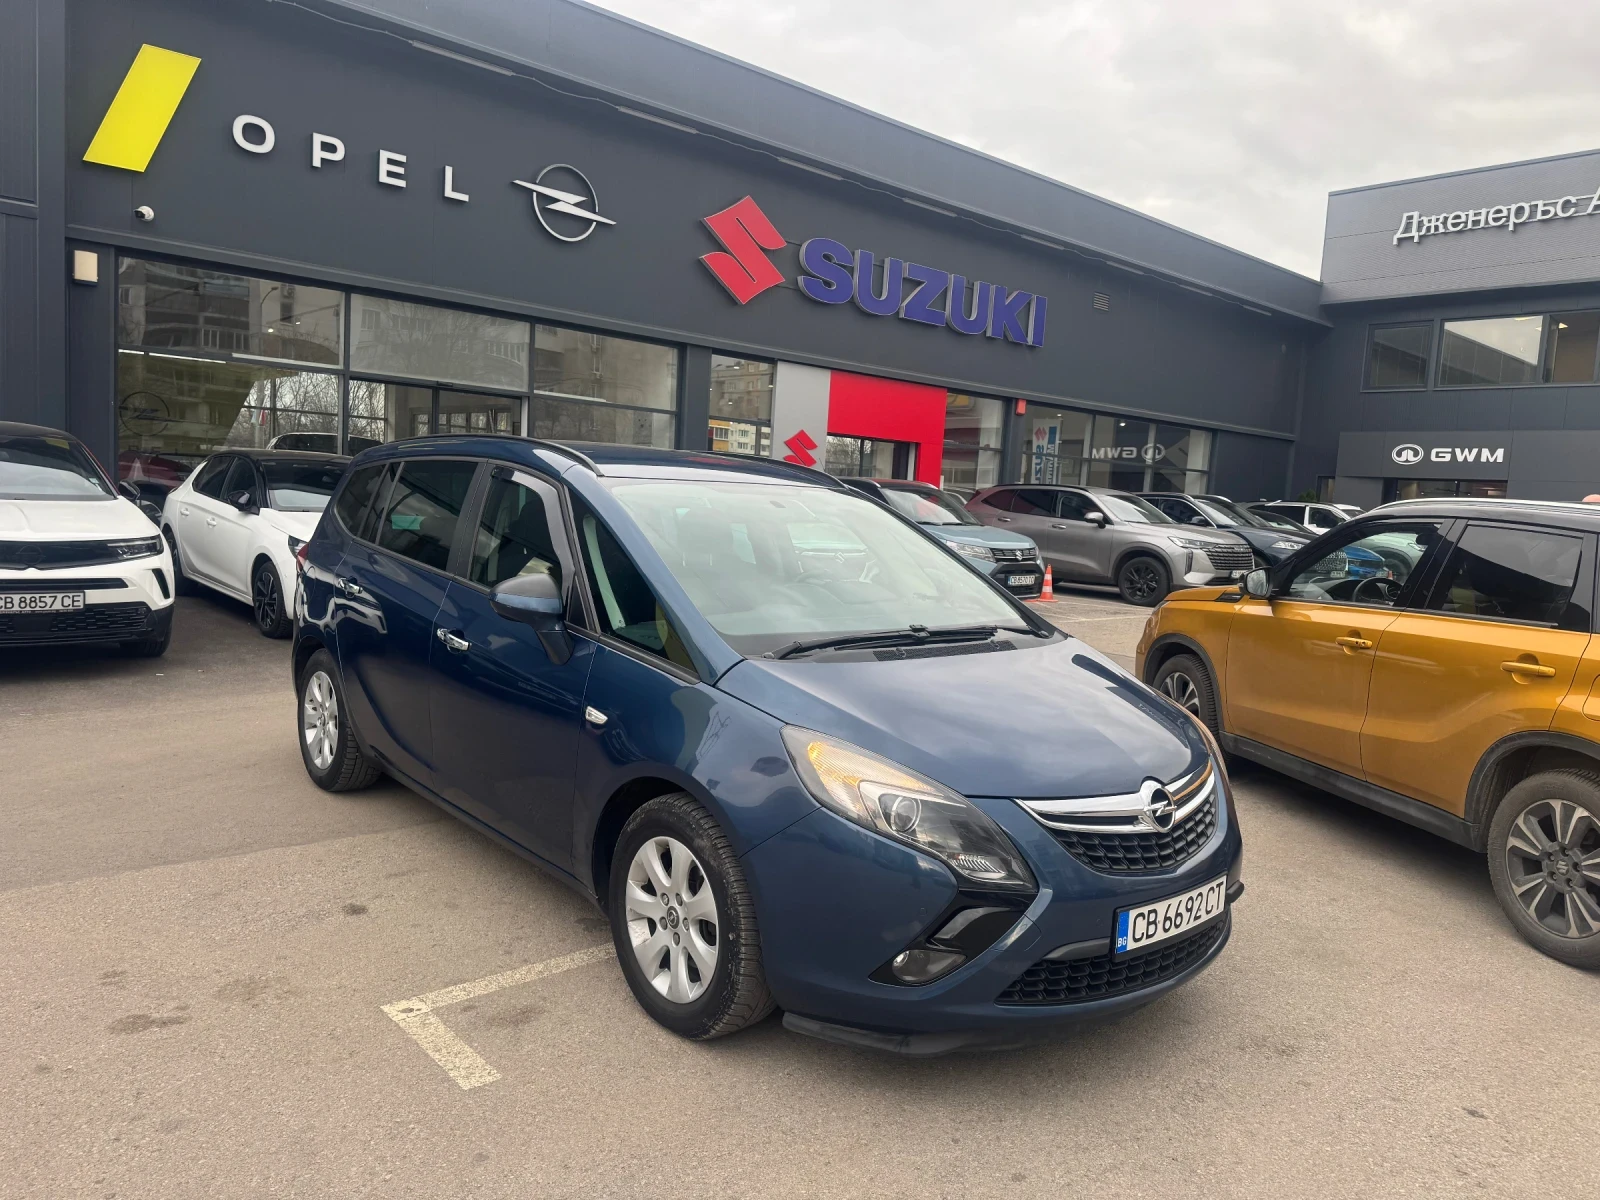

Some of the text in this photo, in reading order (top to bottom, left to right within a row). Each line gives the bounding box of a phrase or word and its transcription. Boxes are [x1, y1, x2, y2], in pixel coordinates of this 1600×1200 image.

[231, 113, 470, 204] OPEL
[1392, 195, 1578, 246] Дженеръс
[797, 236, 1049, 349] SUZUKI
[1430, 447, 1505, 463] GWM
[18, 595, 58, 609] 8857
[61, 594, 82, 608] CE
[1117, 880, 1224, 947] BG CB 6692 CT
